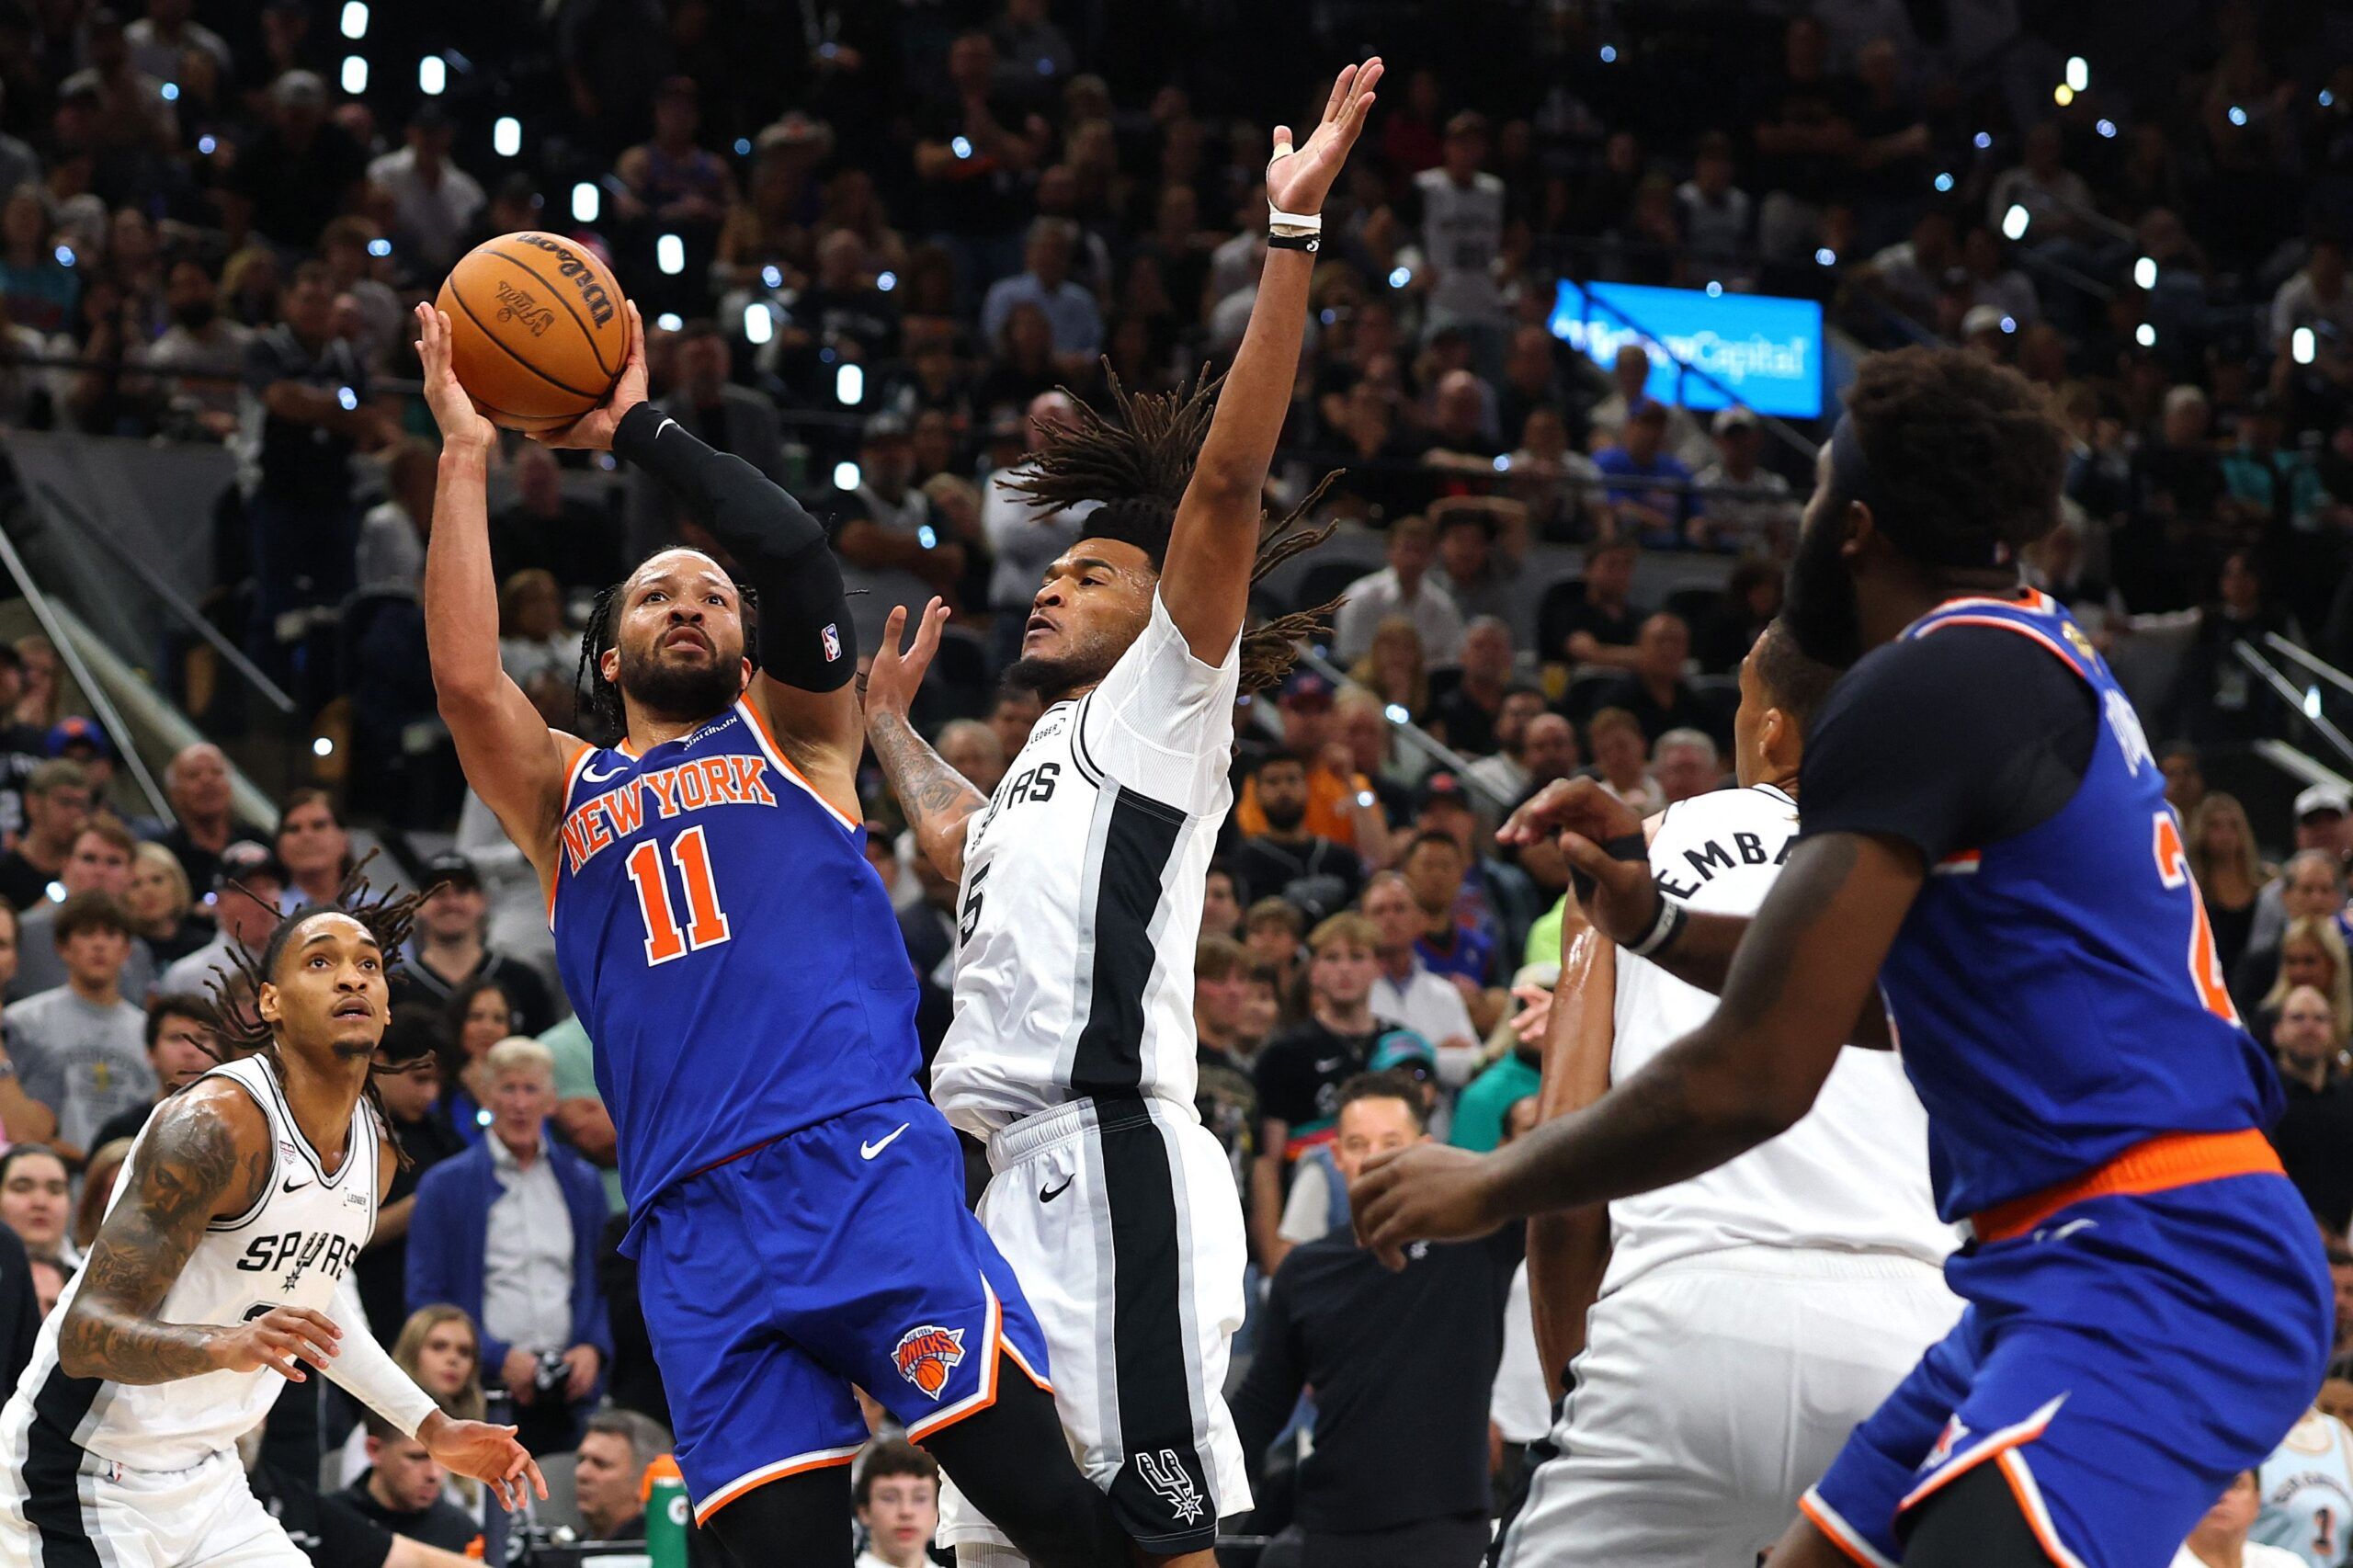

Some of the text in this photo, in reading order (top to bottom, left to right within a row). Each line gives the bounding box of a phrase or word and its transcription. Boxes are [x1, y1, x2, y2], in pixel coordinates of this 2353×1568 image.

[517, 234, 615, 330] Wilson
[562, 754, 779, 879] NEW YORK
[625, 824, 731, 968] 11
[960, 860, 994, 950] 5
[236, 1231, 359, 1282] SPURS
[899, 1330, 961, 1376] KNICKS
